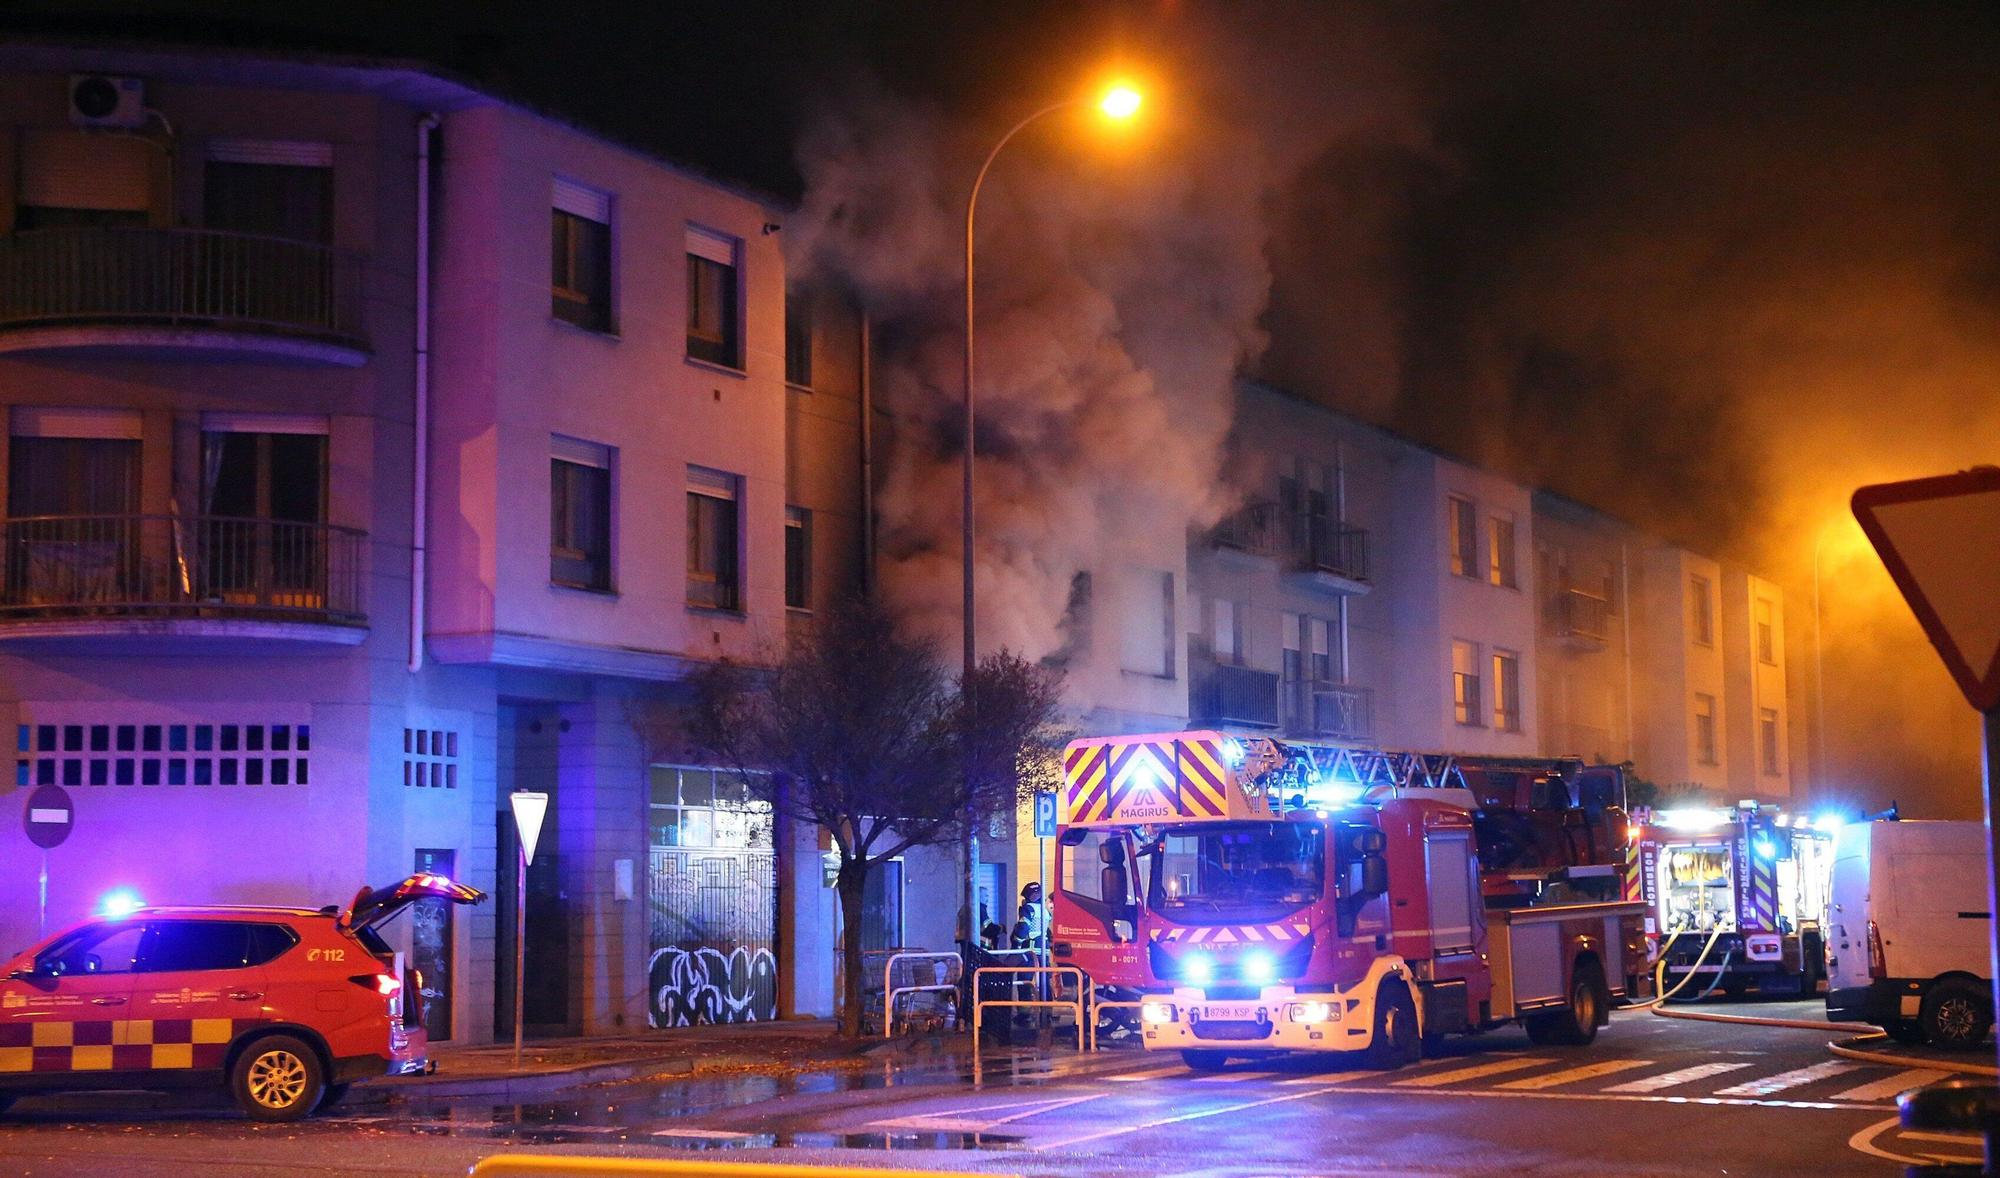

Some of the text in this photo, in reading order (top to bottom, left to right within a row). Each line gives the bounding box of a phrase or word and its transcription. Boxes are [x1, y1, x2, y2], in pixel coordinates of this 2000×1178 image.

[1040, 798, 1054, 832] P
[1121, 806, 1169, 818] MAGIRUS
[1645, 852, 1656, 907] BOMBEROS
[323, 949, 345, 961] 112
[1210, 1007, 1250, 1017] 8799 KSP
